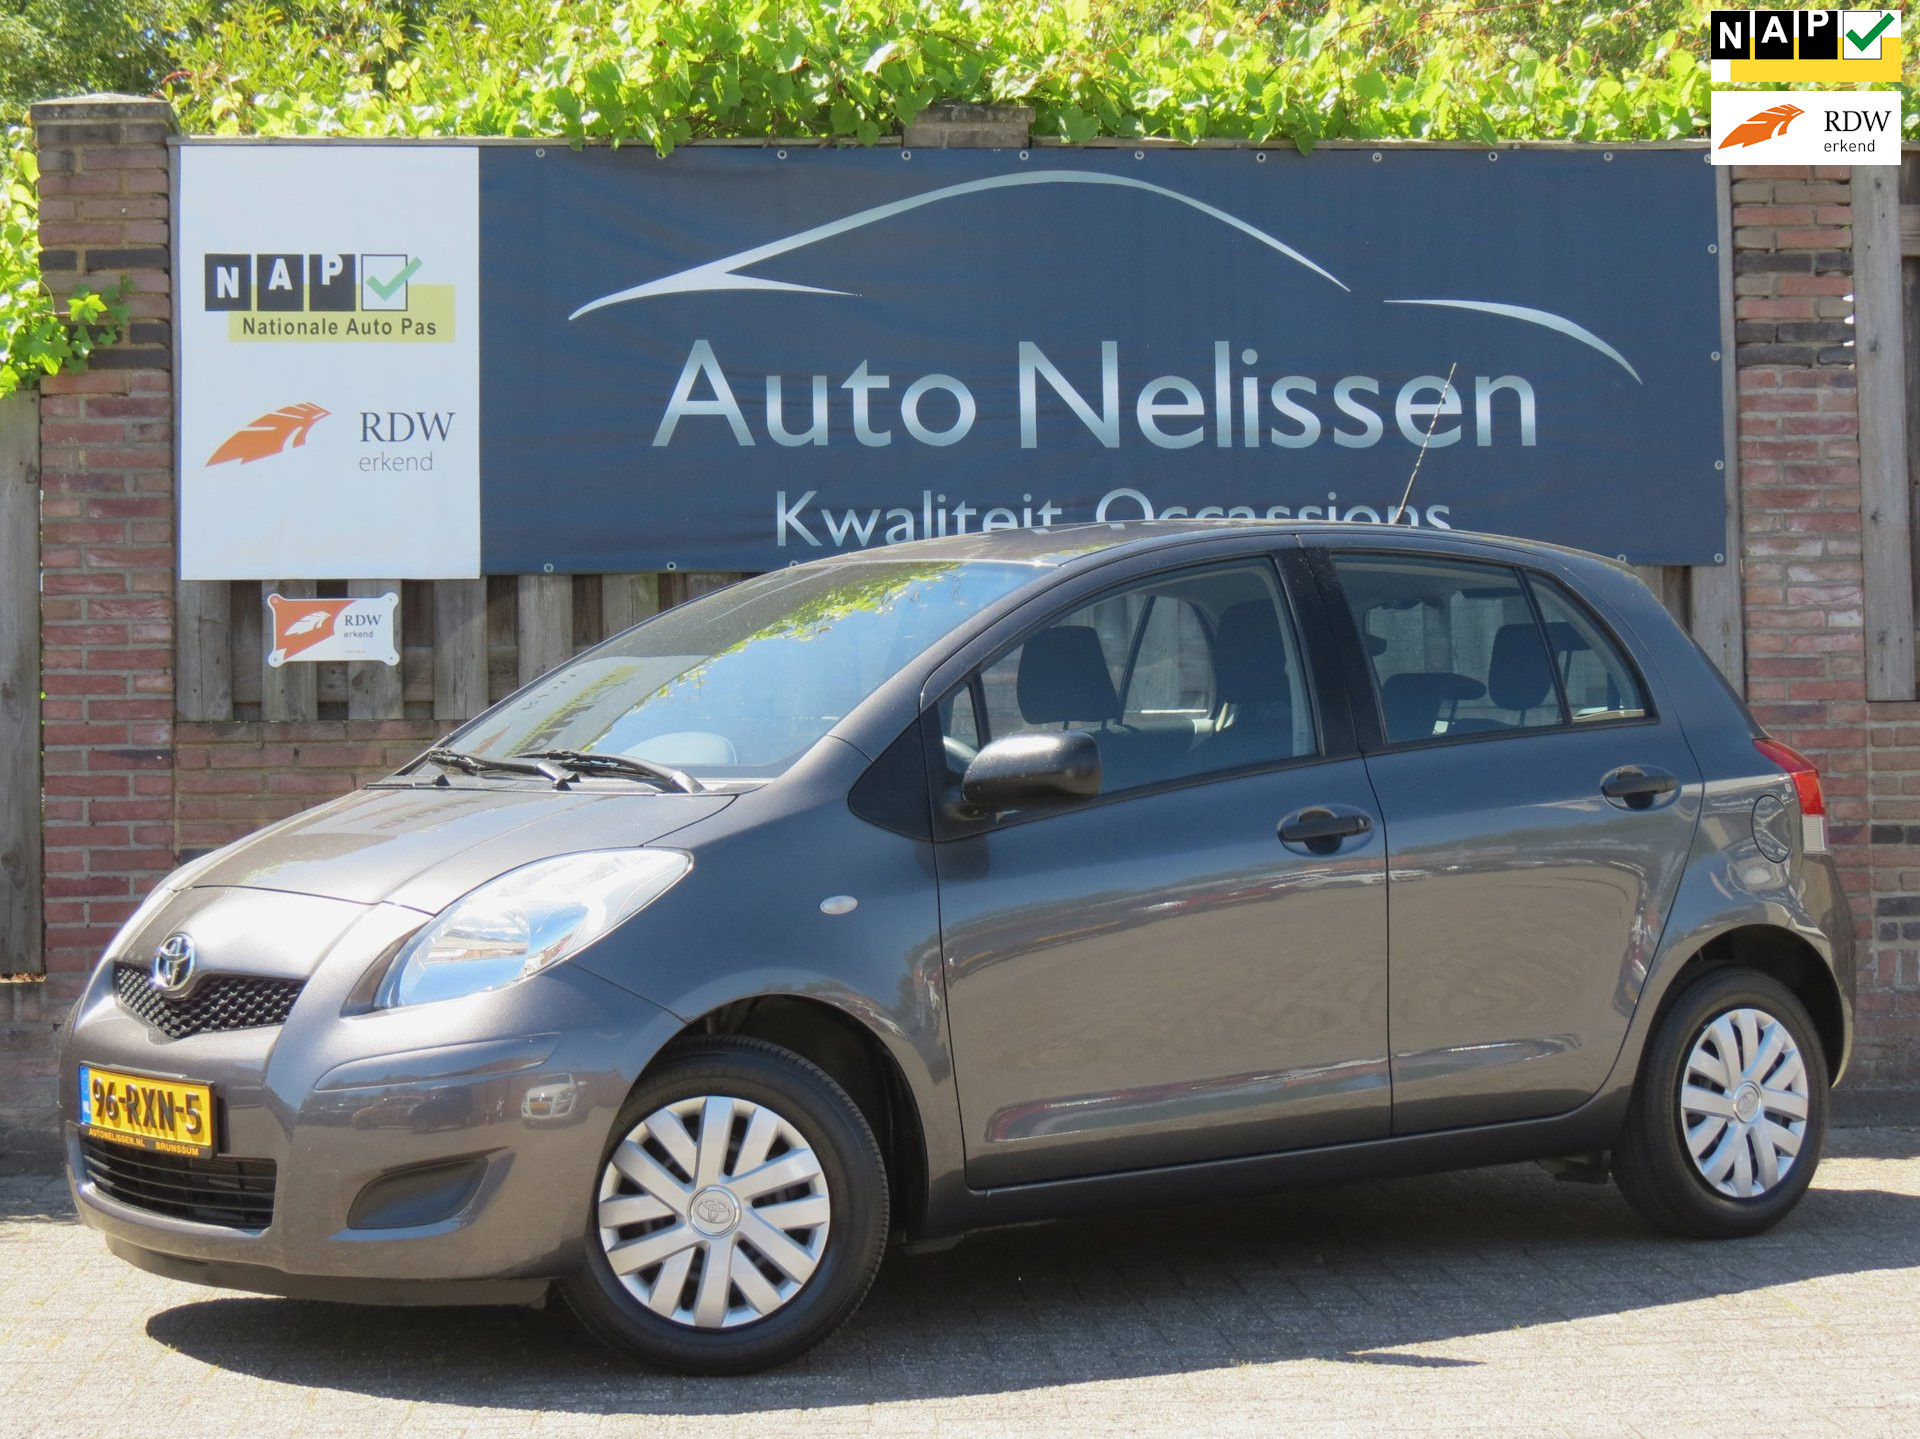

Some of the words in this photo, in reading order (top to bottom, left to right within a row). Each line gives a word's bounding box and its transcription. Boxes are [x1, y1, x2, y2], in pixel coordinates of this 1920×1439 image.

[216, 254, 343, 299] NAP
[243, 317, 338, 336] Nationale
[346, 317, 393, 336] Auto
[401, 317, 437, 336] Pas
[651, 339, 978, 449] Auto
[1018, 340, 1537, 450] Nelissen
[359, 411, 456, 443] RDW
[358, 451, 434, 472] erkend
[344, 614, 382, 627] RDW
[343, 630, 374, 639] erkend
[92, 1077, 202, 1134] 96-RXN-5
[155, 1141, 199, 1157] BRUNSSUM
